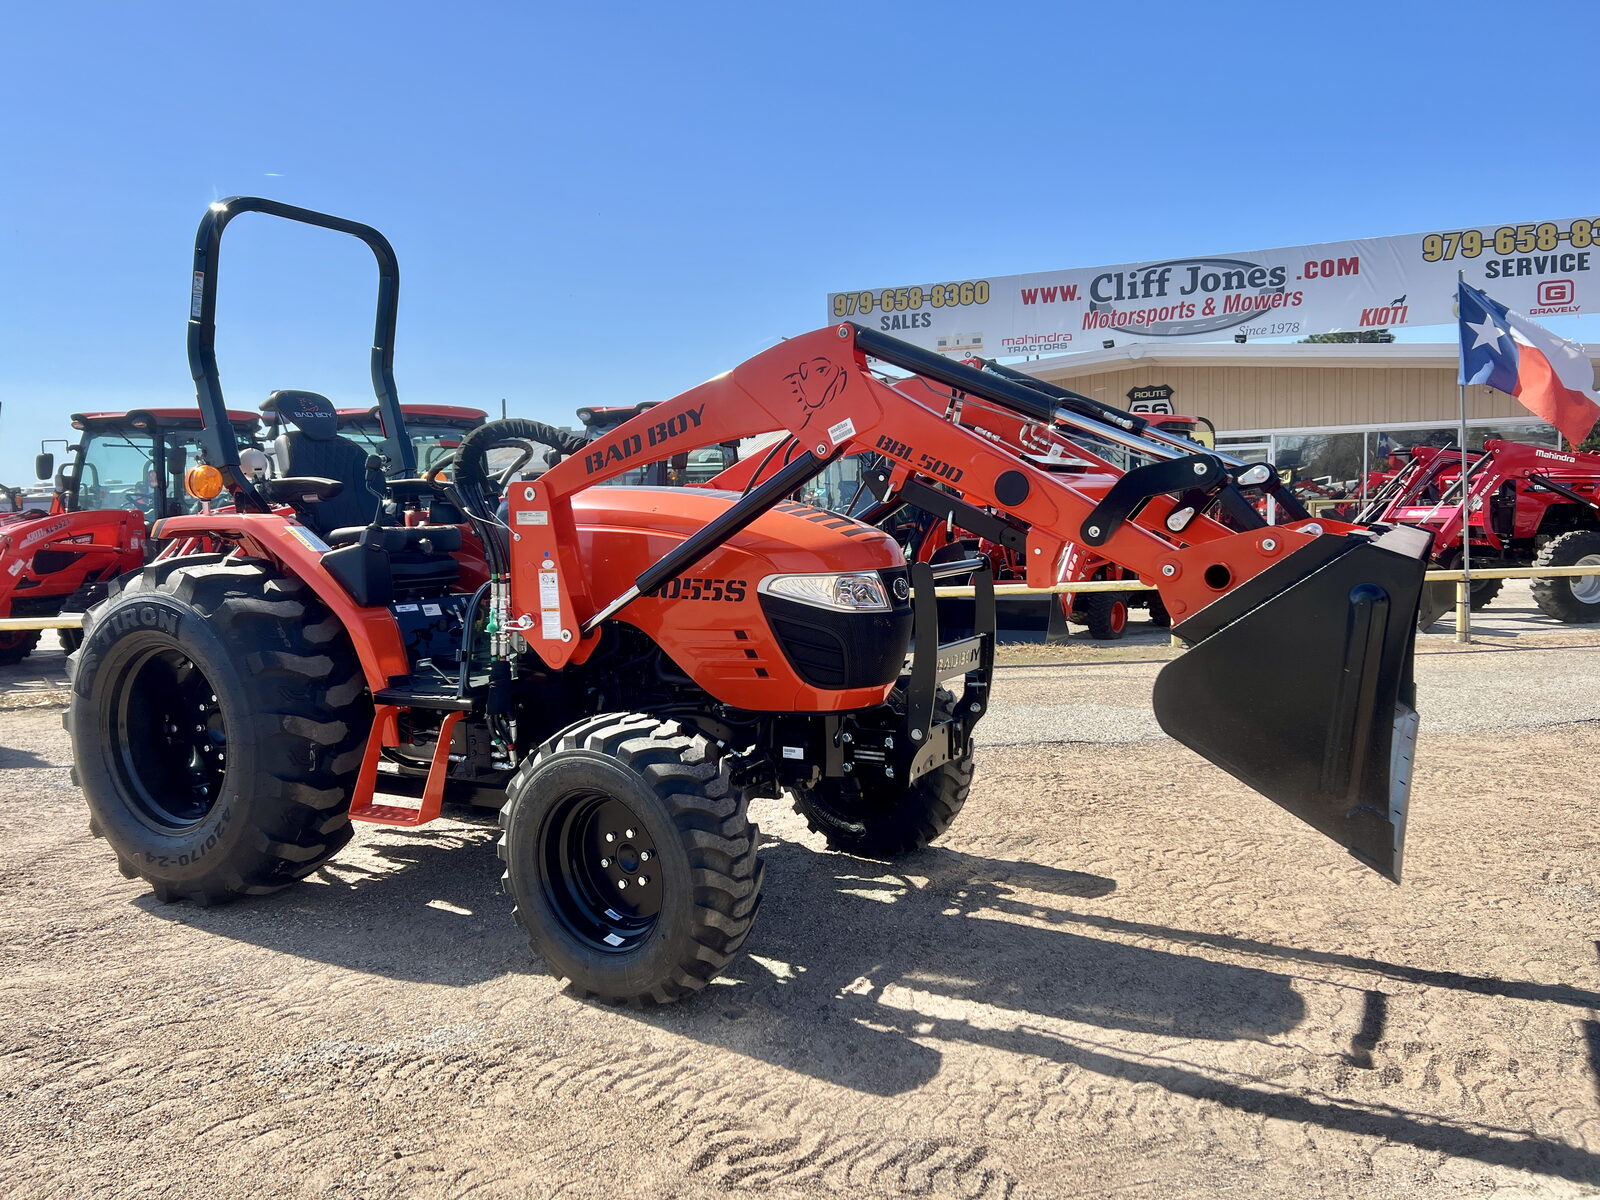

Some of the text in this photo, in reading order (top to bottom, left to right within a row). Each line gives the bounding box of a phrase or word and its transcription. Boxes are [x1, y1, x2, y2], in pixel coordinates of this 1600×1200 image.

[1296, 257, 1359, 280] .COM
[1485, 252, 1591, 278] SERVICE
[1089, 265, 1287, 303] Cliff Jones
[834, 281, 990, 317] 979-658-8360
[1082, 290, 1304, 330] Motorsports & Mowers
[1359, 306, 1409, 326] KIOTI
[1529, 306, 1581, 315] GRAVELY
[880, 312, 932, 331] SALES
[1238, 322, 1300, 336] Since 1978
[1001, 332, 1073, 346] mahindra
[1007, 342, 1068, 353] TRACTORS
[1134, 389, 1167, 399] ROUTE
[585, 403, 705, 475] BAD BOY
[875, 435, 964, 483] BBL 500
[1535, 449, 1576, 463] Mahindra
